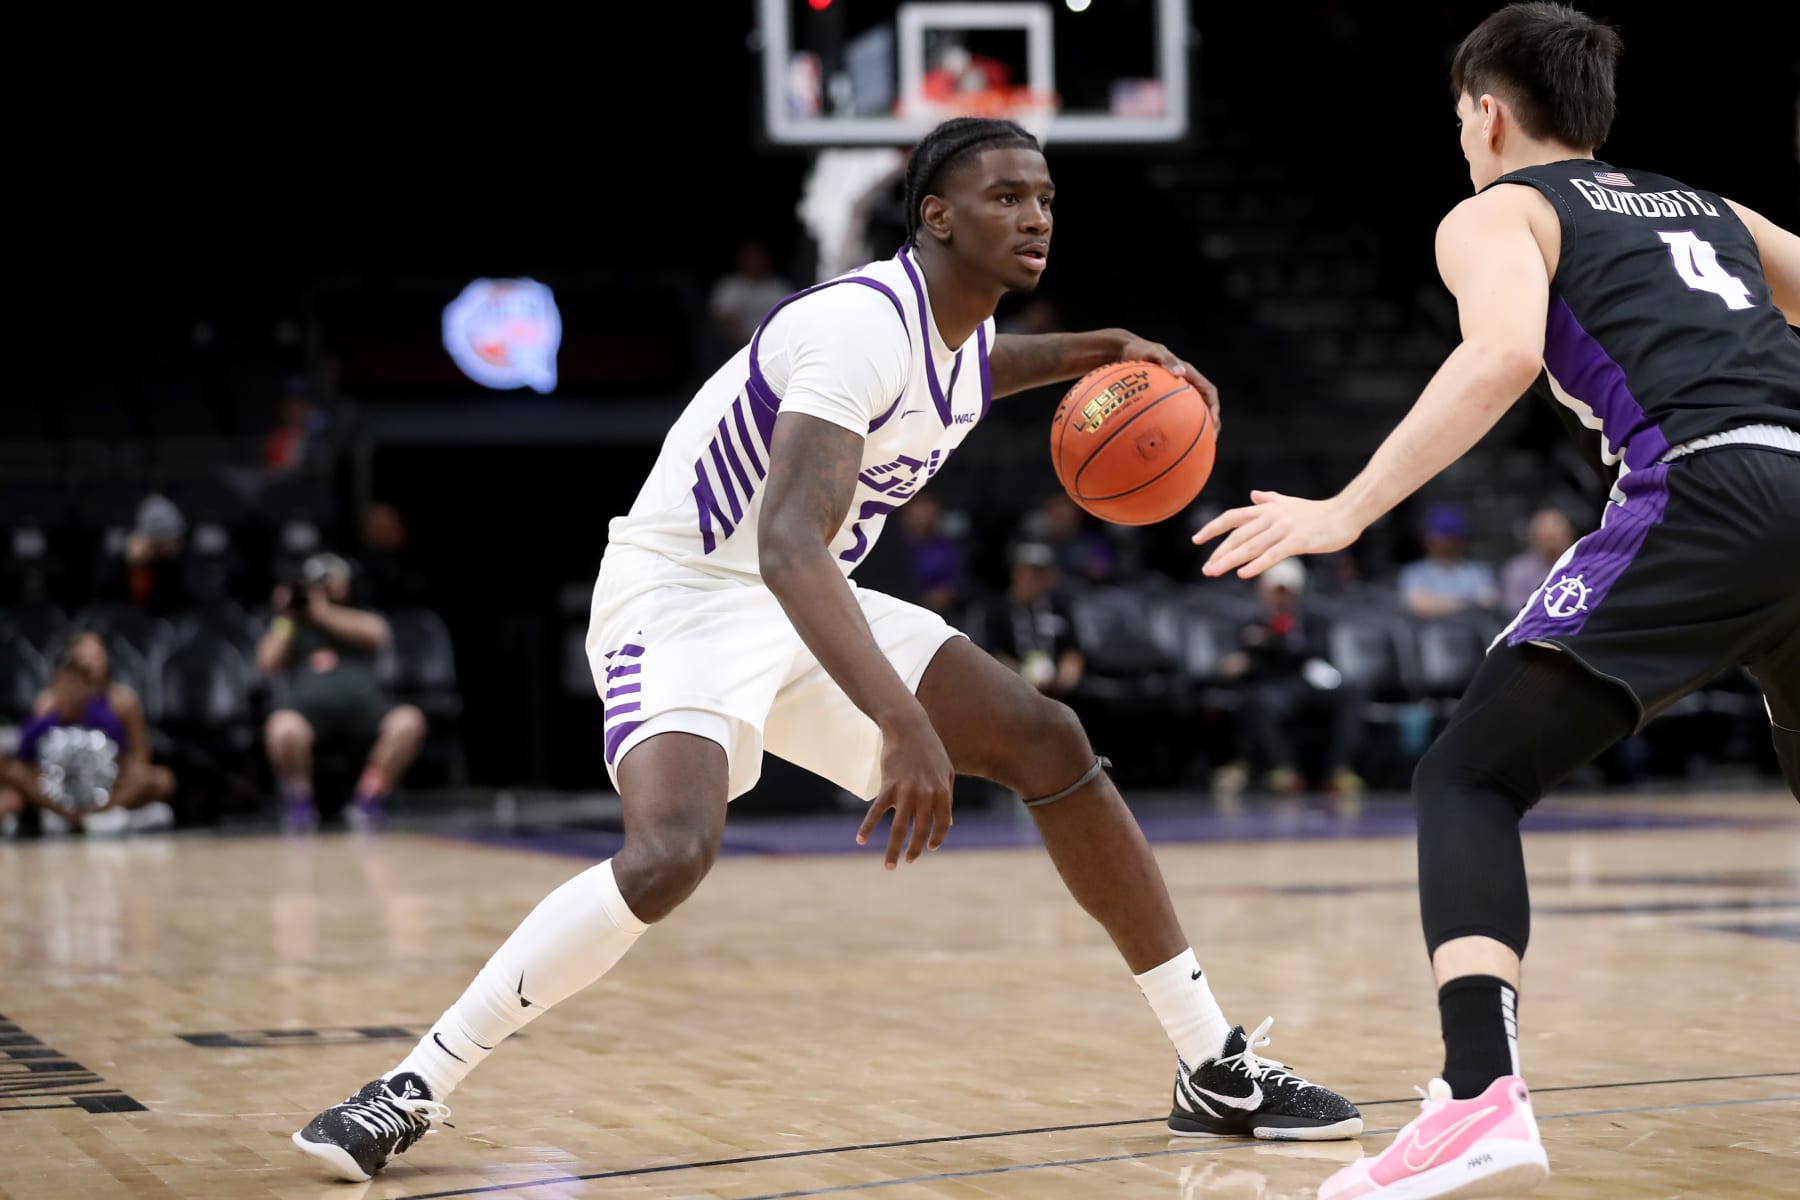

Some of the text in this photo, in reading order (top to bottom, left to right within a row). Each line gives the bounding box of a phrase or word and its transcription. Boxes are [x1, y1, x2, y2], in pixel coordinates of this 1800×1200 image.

[1653, 229, 1758, 311] 4
[953, 412, 976, 425] WAC
[1073, 370, 1148, 432] LEGACY
